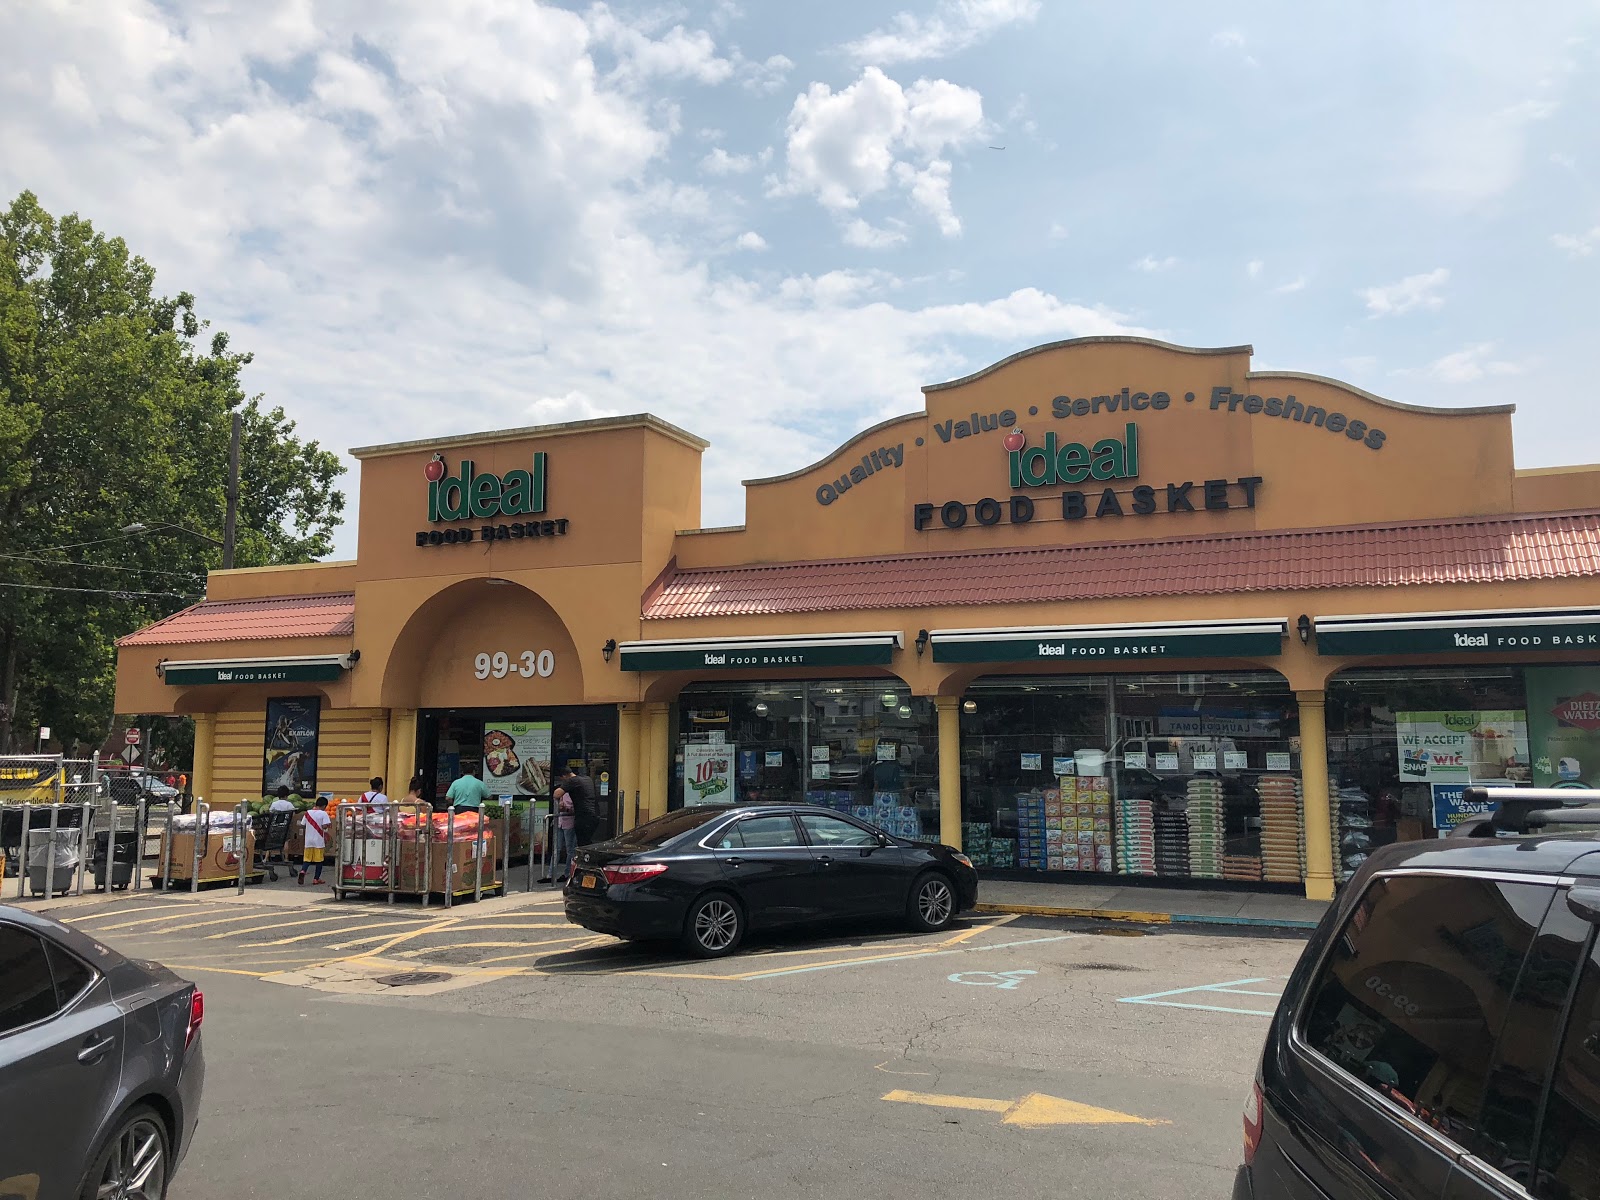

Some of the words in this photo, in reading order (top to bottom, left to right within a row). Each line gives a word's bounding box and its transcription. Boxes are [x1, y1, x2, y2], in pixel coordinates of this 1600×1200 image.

[814, 441, 904, 507] Quality
[933, 406, 1017, 444] Value
[1051, 387, 1170, 419] Service
[1210, 386, 1388, 450] Freshness
[1002, 422, 1140, 488] ideal
[423, 451, 548, 523] ideal
[914, 495, 1035, 531] FOOD
[1062, 476, 1264, 521] BASKET
[415, 526, 473, 547] FOOD
[481, 518, 569, 541] BASKET
[1454, 633, 1489, 647] ideal
[1497, 636, 1542, 646] FOOD
[1038, 642, 1065, 656] ideal
[1071, 646, 1107, 655] FOOD
[1113, 644, 1168, 654] BASKET
[474, 649, 555, 680] 99-30
[704, 653, 726, 666] ideal
[730, 656, 758, 665] FOOD
[763, 655, 805, 664] BASKET
[217, 670, 233, 681] ideal
[1444, 713, 1475, 726] ideal
[1402, 735, 1420, 745] WE
[1424, 735, 1466, 745] ACCEPT
[1403, 763, 1428, 771] SNAP
[1433, 755, 1464, 765] WIC
[1458, 804, 1489, 813] SAVE
